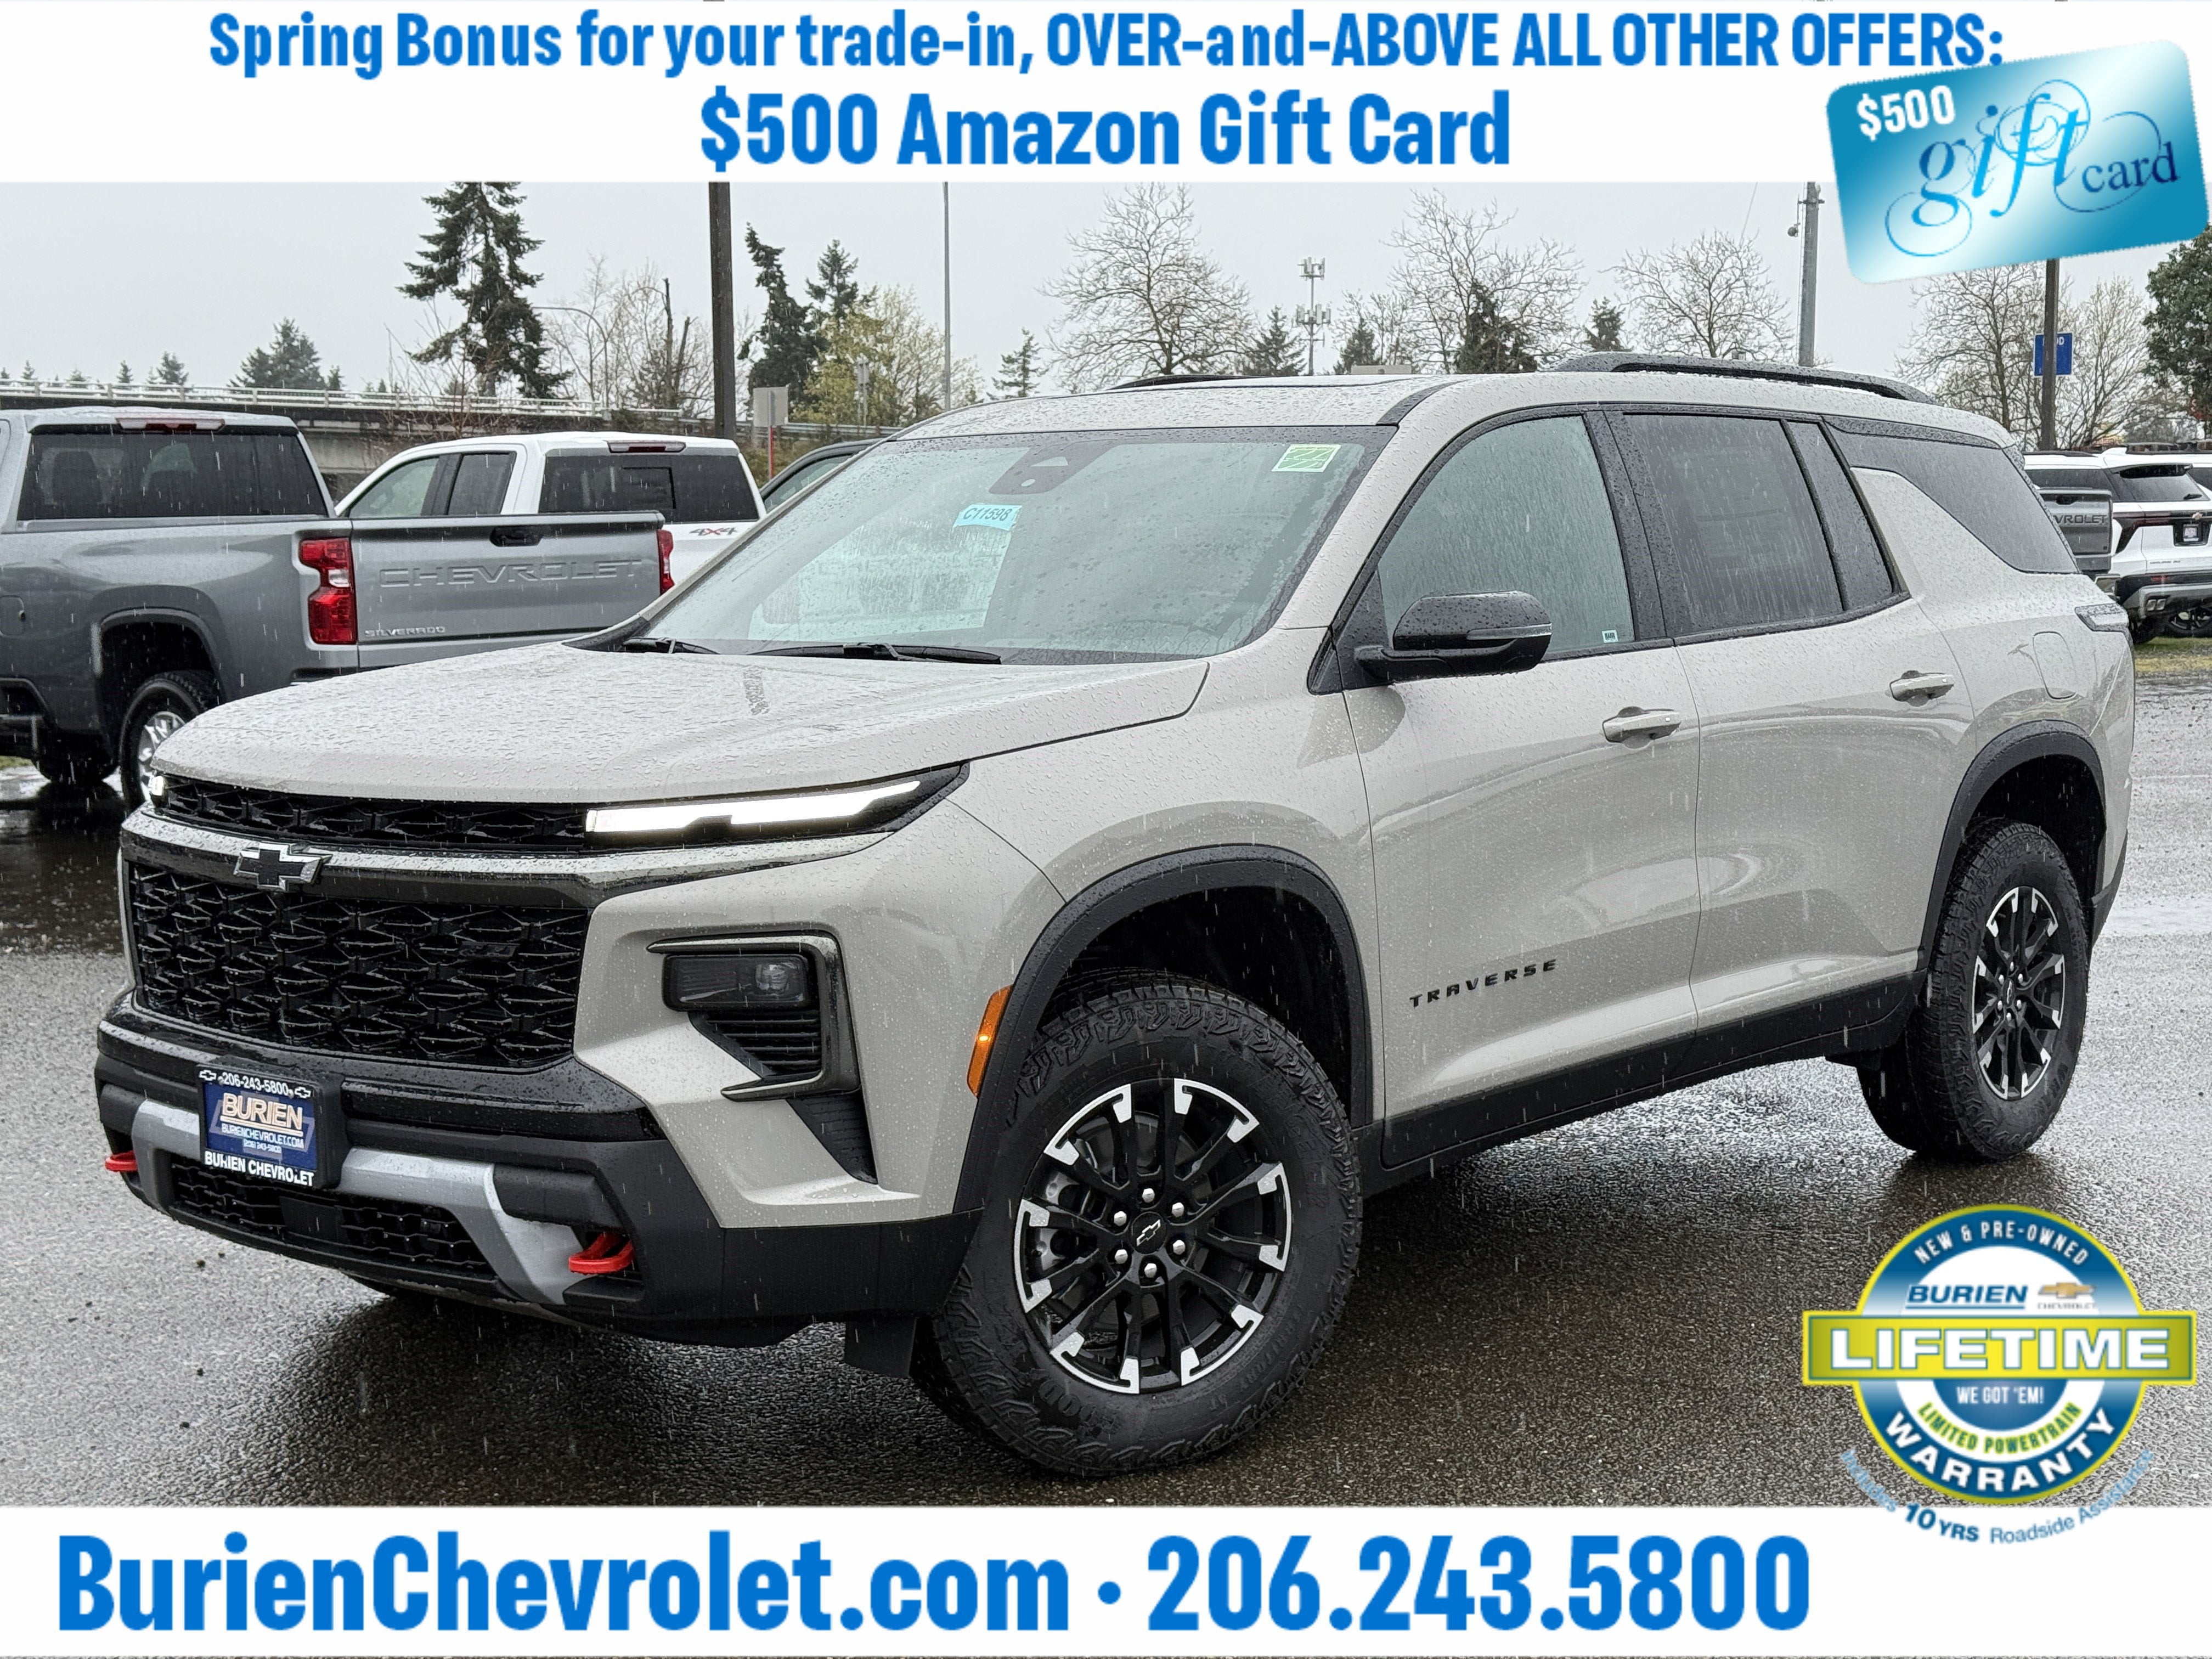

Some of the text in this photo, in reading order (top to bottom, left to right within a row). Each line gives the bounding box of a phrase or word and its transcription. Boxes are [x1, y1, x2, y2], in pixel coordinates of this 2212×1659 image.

[963, 507, 1012, 521] C11598
[2053, 515, 2107, 524] VROLET
[380, 558, 642, 588] CHEVROLET
[364, 626, 445, 637] SILVERADO
[1409, 959, 1556, 1009] TRAVERSE
[222, 1071, 290, 1096] 206-243-5800
[222, 1092, 303, 1130] BURIEN
[205, 1150, 314, 1187] BURIEN CHEVROLET
